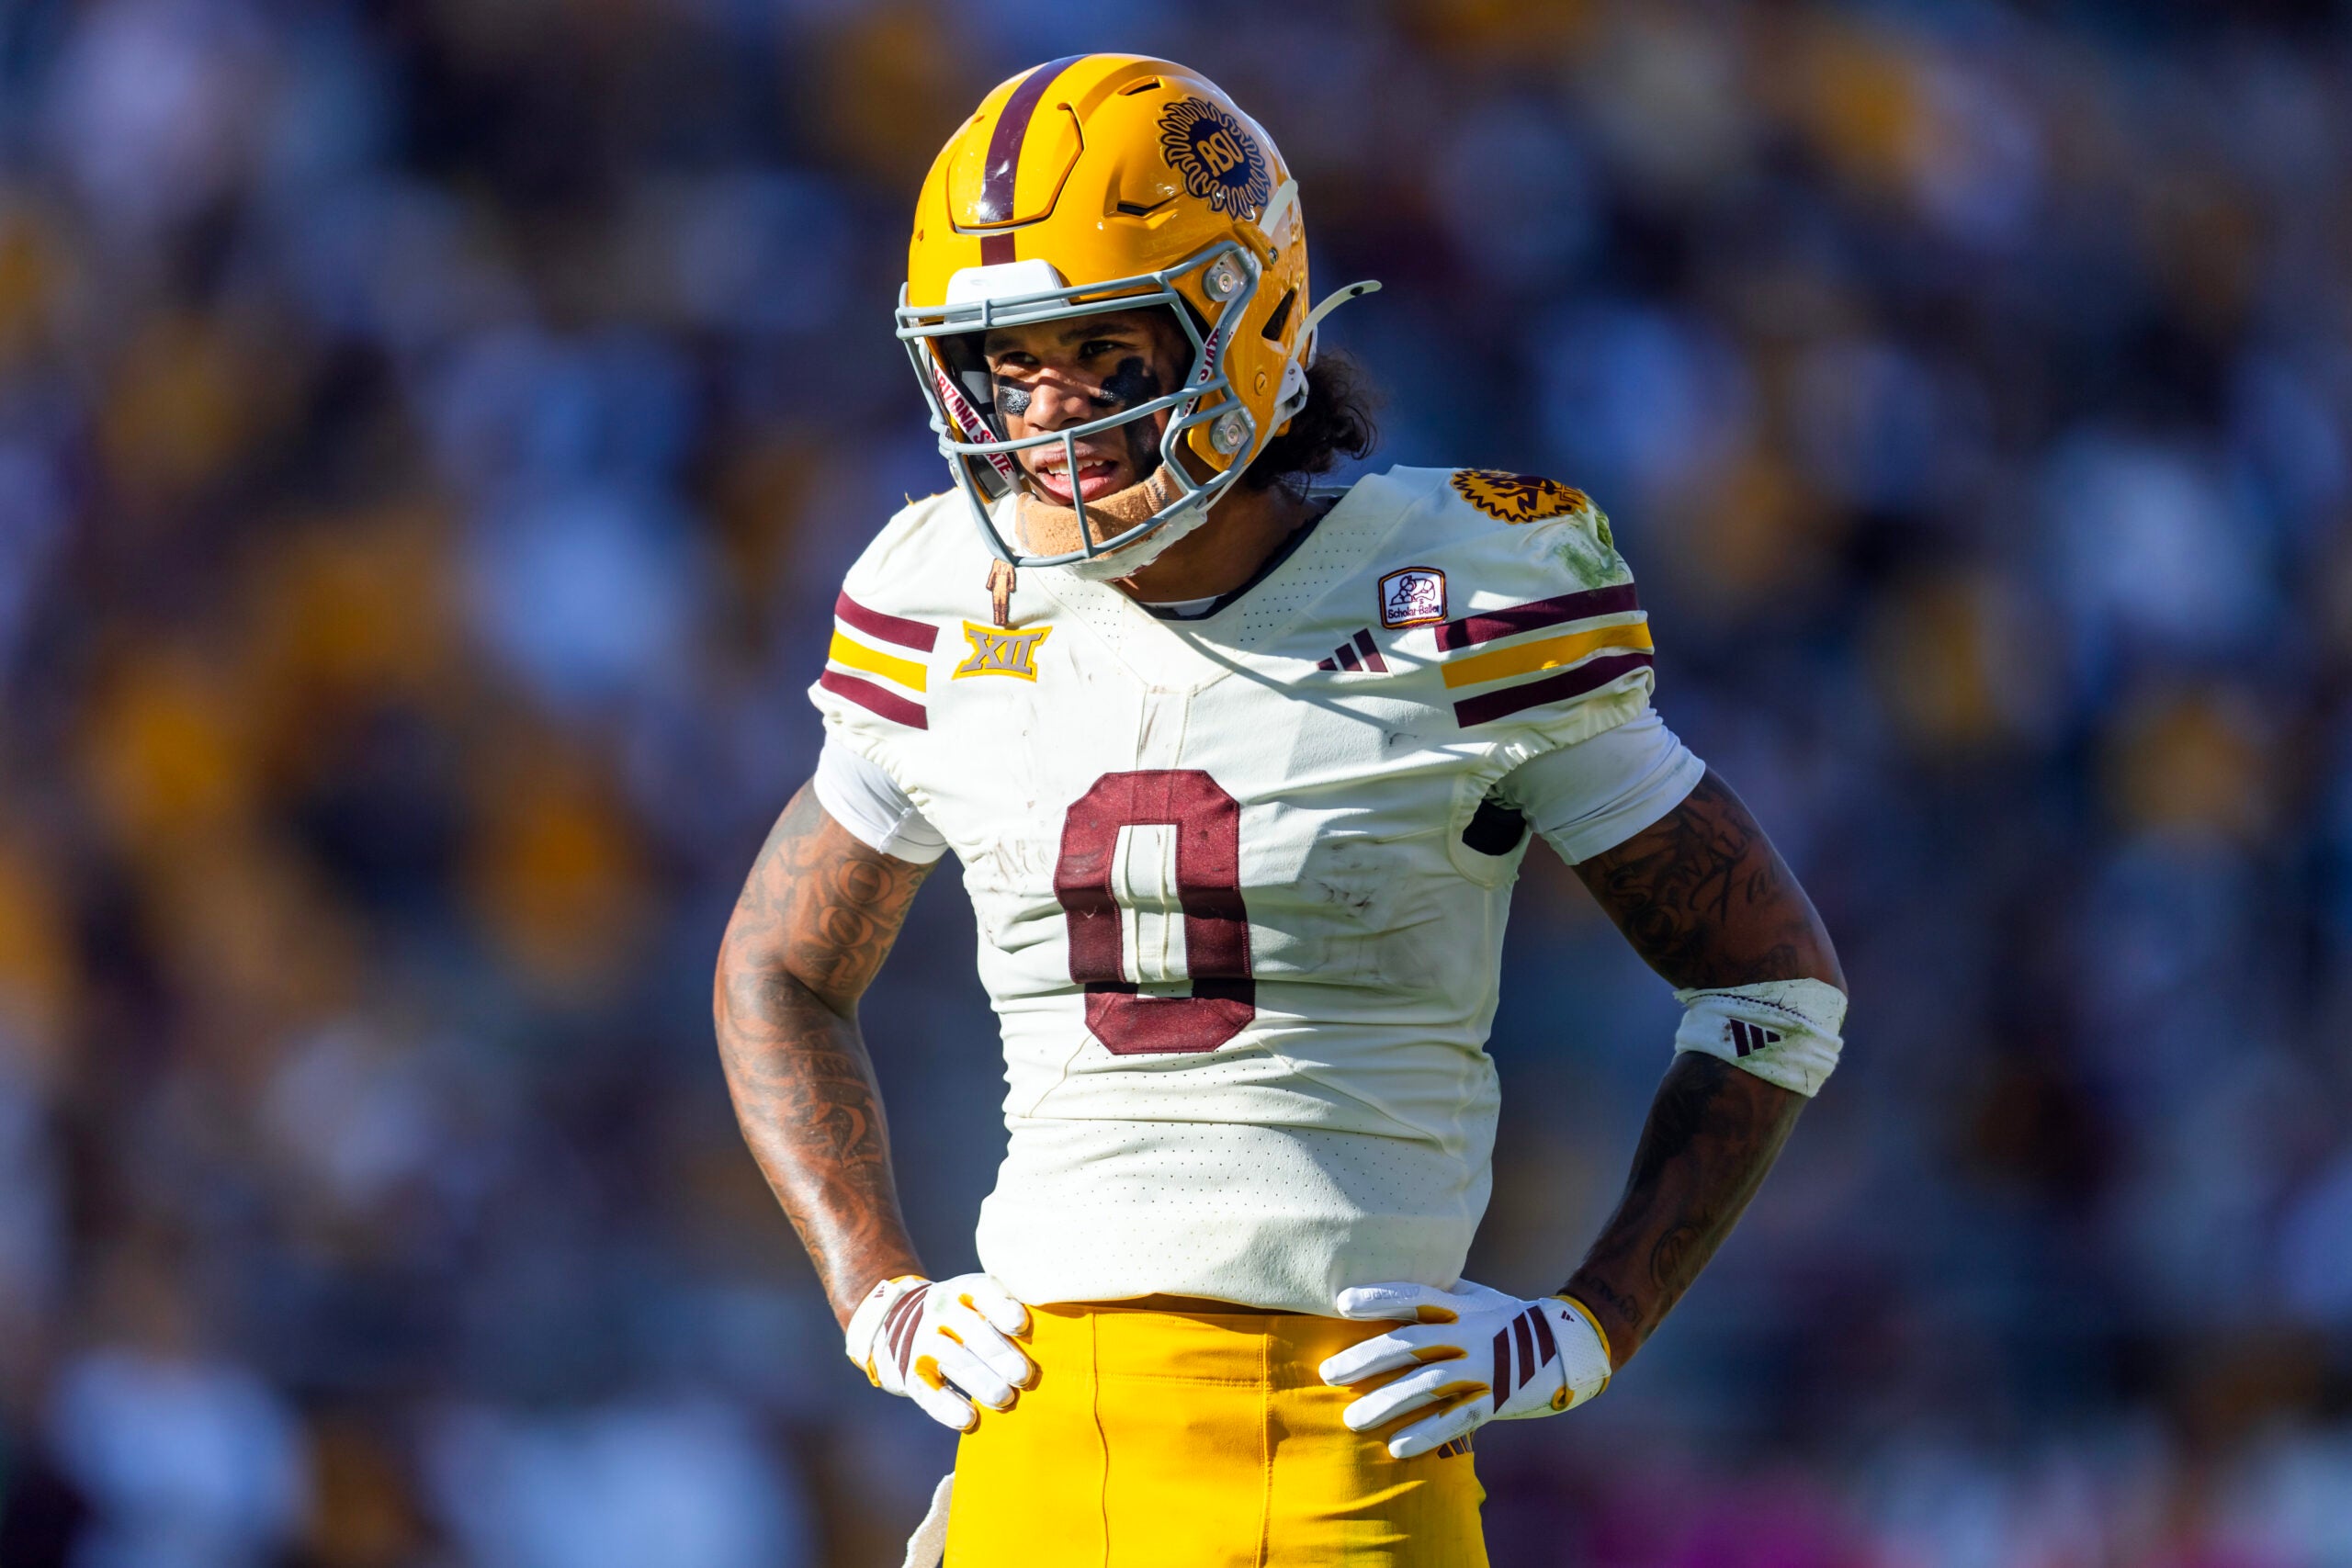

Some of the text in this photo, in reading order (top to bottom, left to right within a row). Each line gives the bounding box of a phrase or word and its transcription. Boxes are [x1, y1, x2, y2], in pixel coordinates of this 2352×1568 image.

[1197, 129, 1244, 177] ASU
[956, 625, 1048, 680] XII
[1054, 769, 1256, 1055] 0
